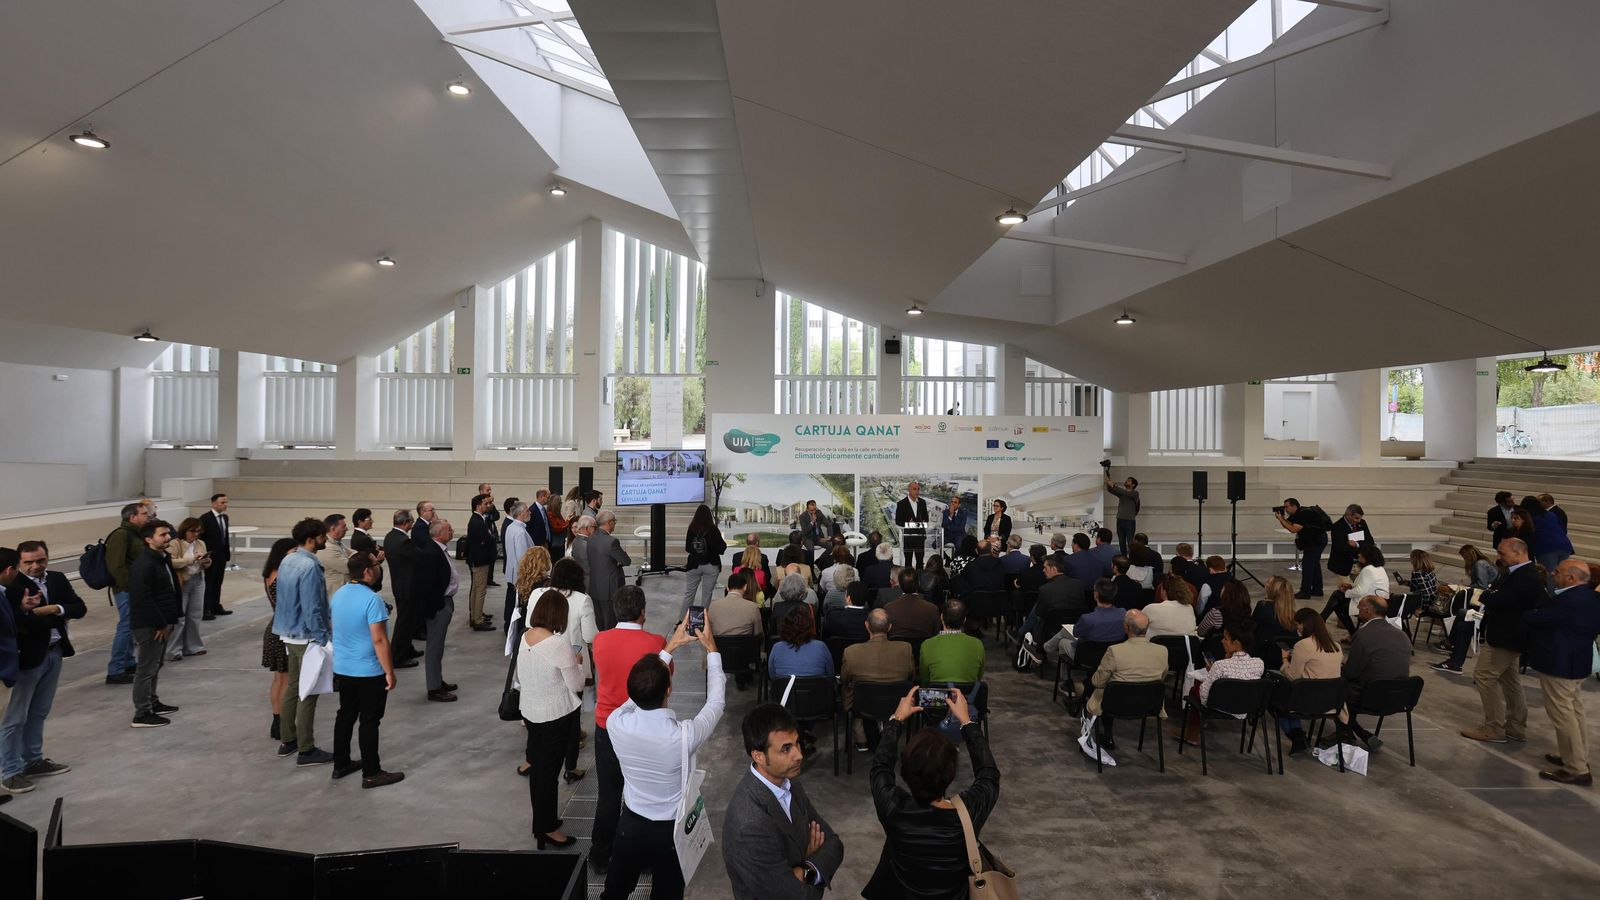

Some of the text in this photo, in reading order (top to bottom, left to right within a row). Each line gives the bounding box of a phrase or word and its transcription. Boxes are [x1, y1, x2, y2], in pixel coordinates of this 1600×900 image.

[794, 425, 901, 436] CARTUJA QANAT
[732, 437, 751, 447] UIA
[794, 452, 900, 460] climatológicamente cambiante
[686, 813, 697, 829] UIA
